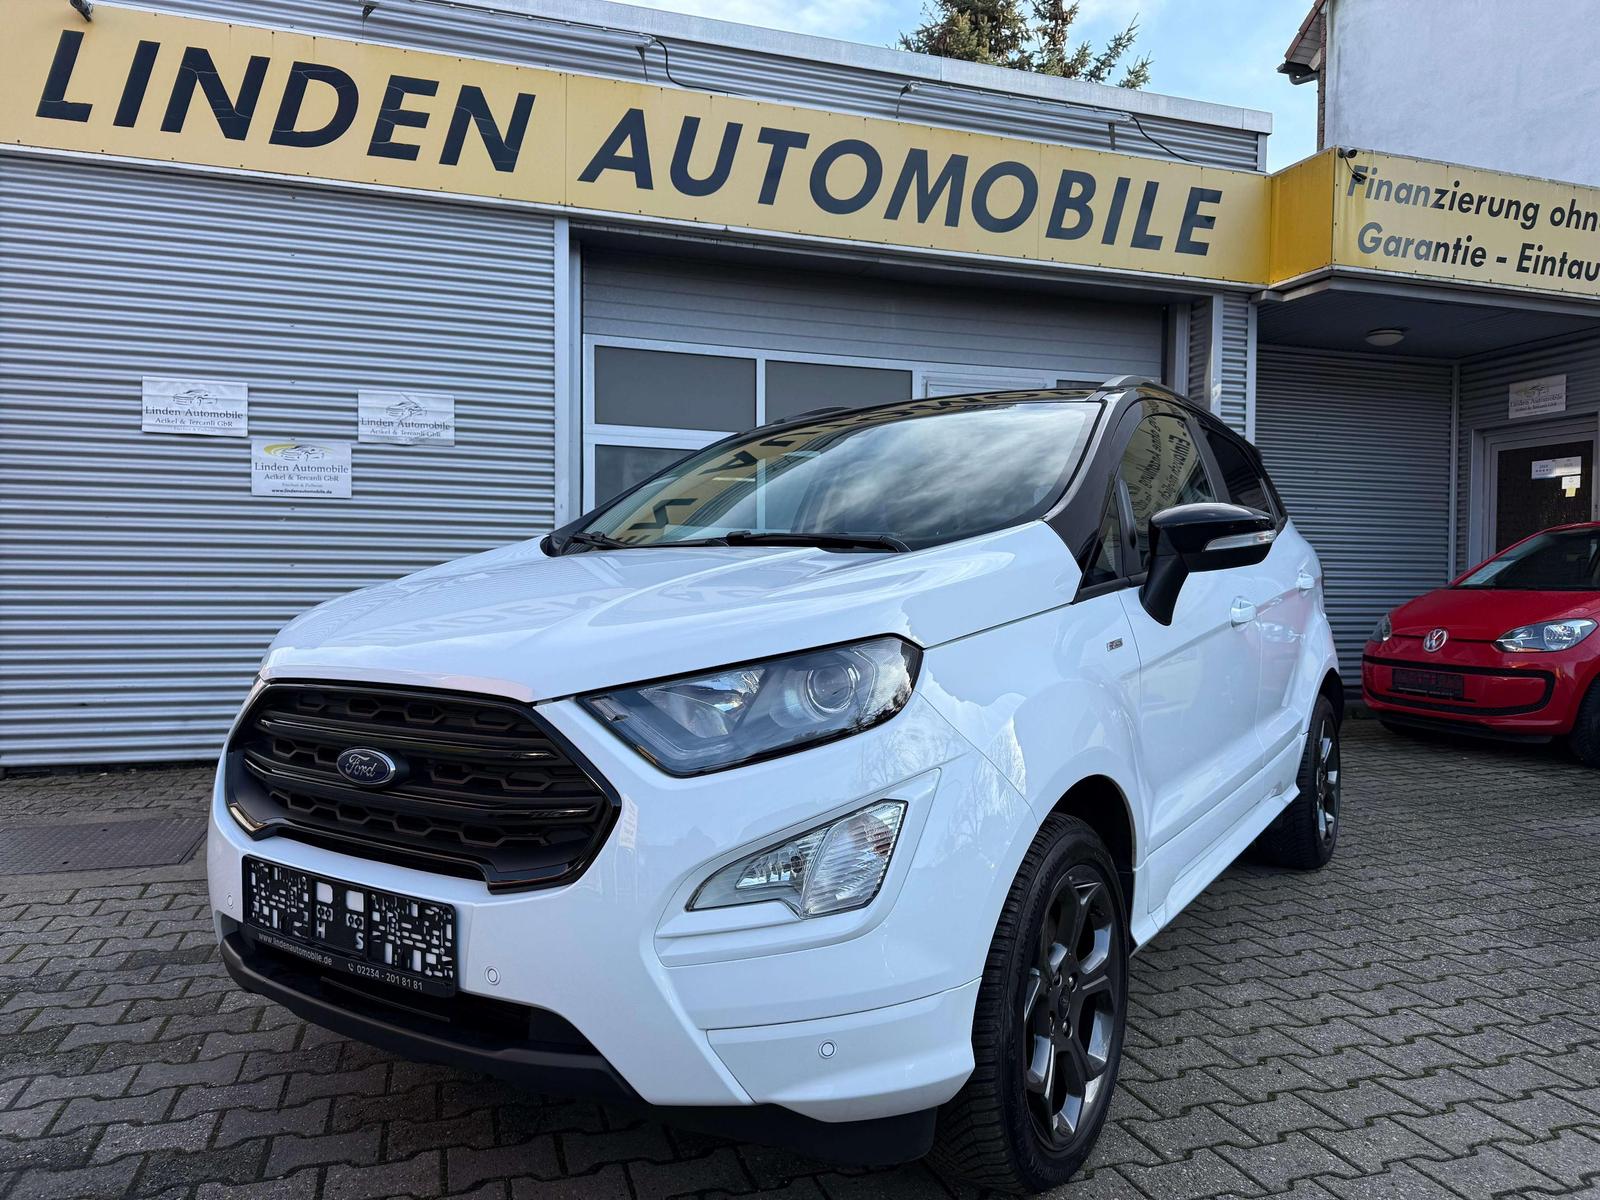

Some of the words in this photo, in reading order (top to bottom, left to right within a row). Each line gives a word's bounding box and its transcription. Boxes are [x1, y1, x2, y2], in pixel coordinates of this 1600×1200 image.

[36, 29, 536, 173] LINDEN
[576, 107, 1221, 257] AUTOMOBILE
[1346, 164, 1540, 230] Finanzierung
[1550, 199, 1600, 232] ohn
[1357, 222, 1487, 267] Garantie
[145, 406, 181, 416] Linden
[185, 409, 243, 419] Automobile
[361, 417, 394, 427] Linden
[398, 420, 450, 431] Automobile
[255, 462, 289, 472] Linden
[292, 464, 349, 474] Automobile
[345, 753, 377, 777] Ford
[356, 964, 380, 978] 02234
[386, 972, 400, 985] 201
[401, 977, 411, 988] 81
[413, 980, 423, 991] 81
